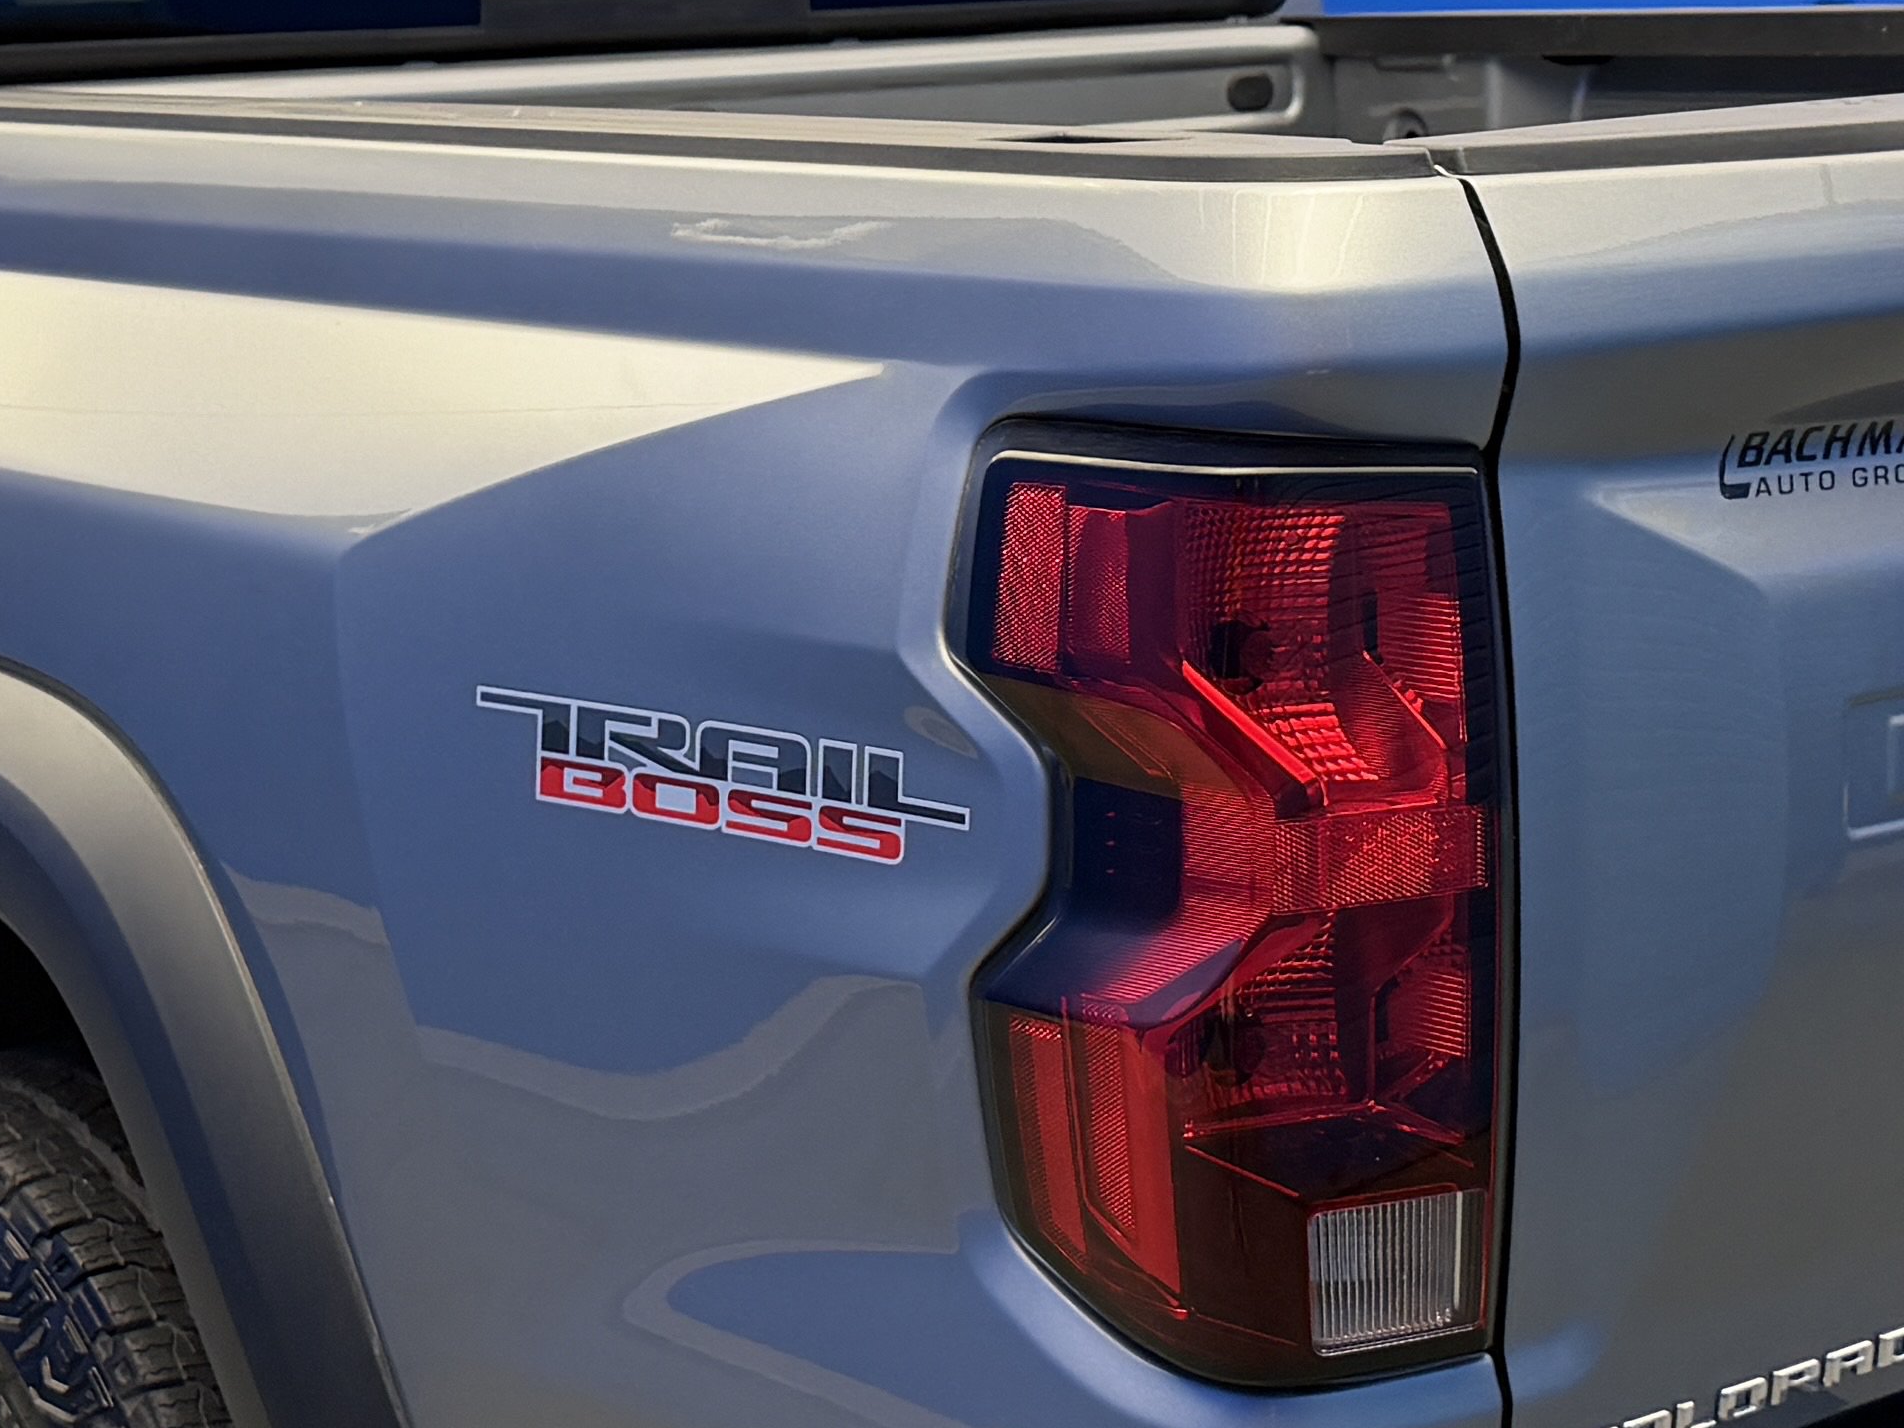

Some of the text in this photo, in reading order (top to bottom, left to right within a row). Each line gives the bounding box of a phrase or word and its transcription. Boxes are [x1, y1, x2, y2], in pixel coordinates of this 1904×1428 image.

[1755, 470, 1836, 498] AUTO
[476, 685, 970, 830] TRAIL
[536, 755, 905, 865] BOSS
